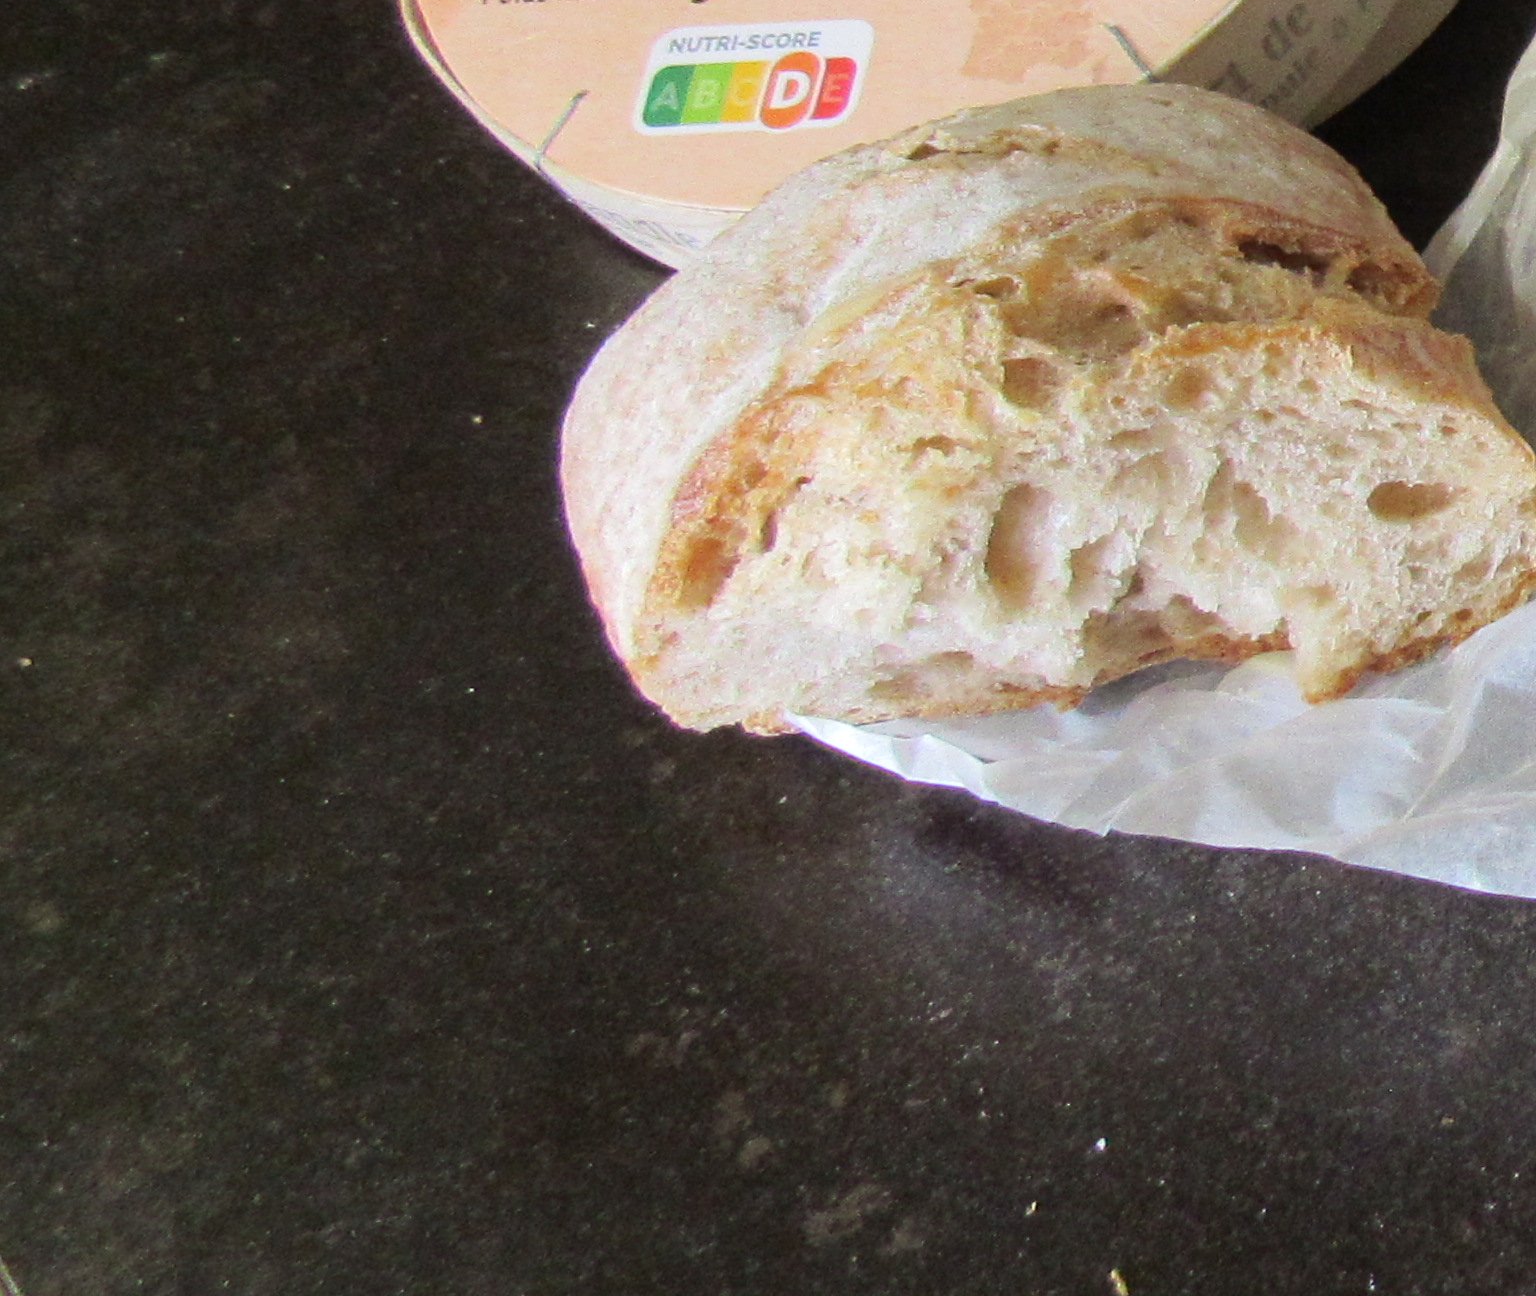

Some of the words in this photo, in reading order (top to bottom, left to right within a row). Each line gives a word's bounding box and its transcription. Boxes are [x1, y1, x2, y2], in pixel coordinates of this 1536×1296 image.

[668, 30, 823, 54] NUTRI-SCORE
[693, 79, 721, 106] B
[769, 70, 812, 109] D
[822, 73, 850, 102] E
